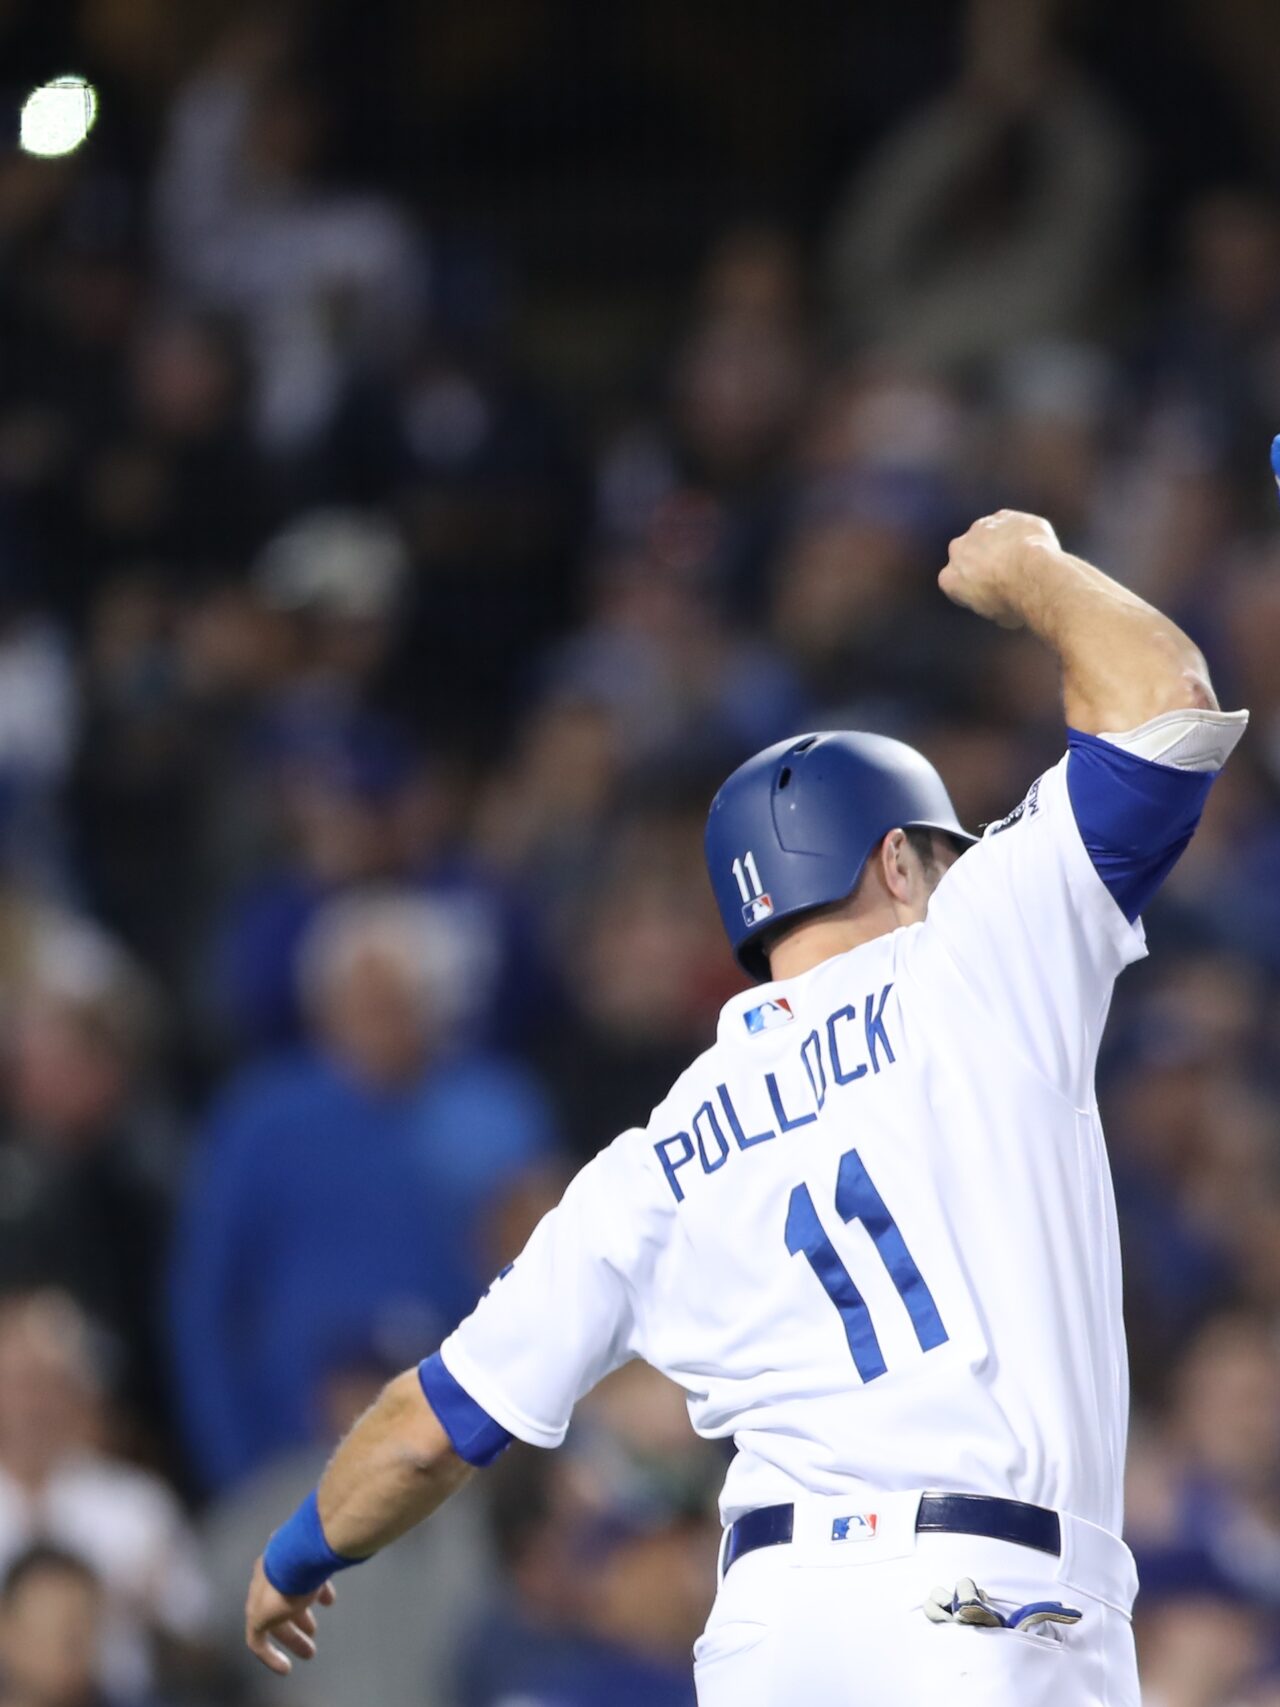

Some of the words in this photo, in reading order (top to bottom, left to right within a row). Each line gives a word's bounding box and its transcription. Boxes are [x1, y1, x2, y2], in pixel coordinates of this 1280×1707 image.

[732, 850, 763, 904] 11
[653, 982, 896, 1203] POLLOCK
[784, 1148, 950, 1384] 11
